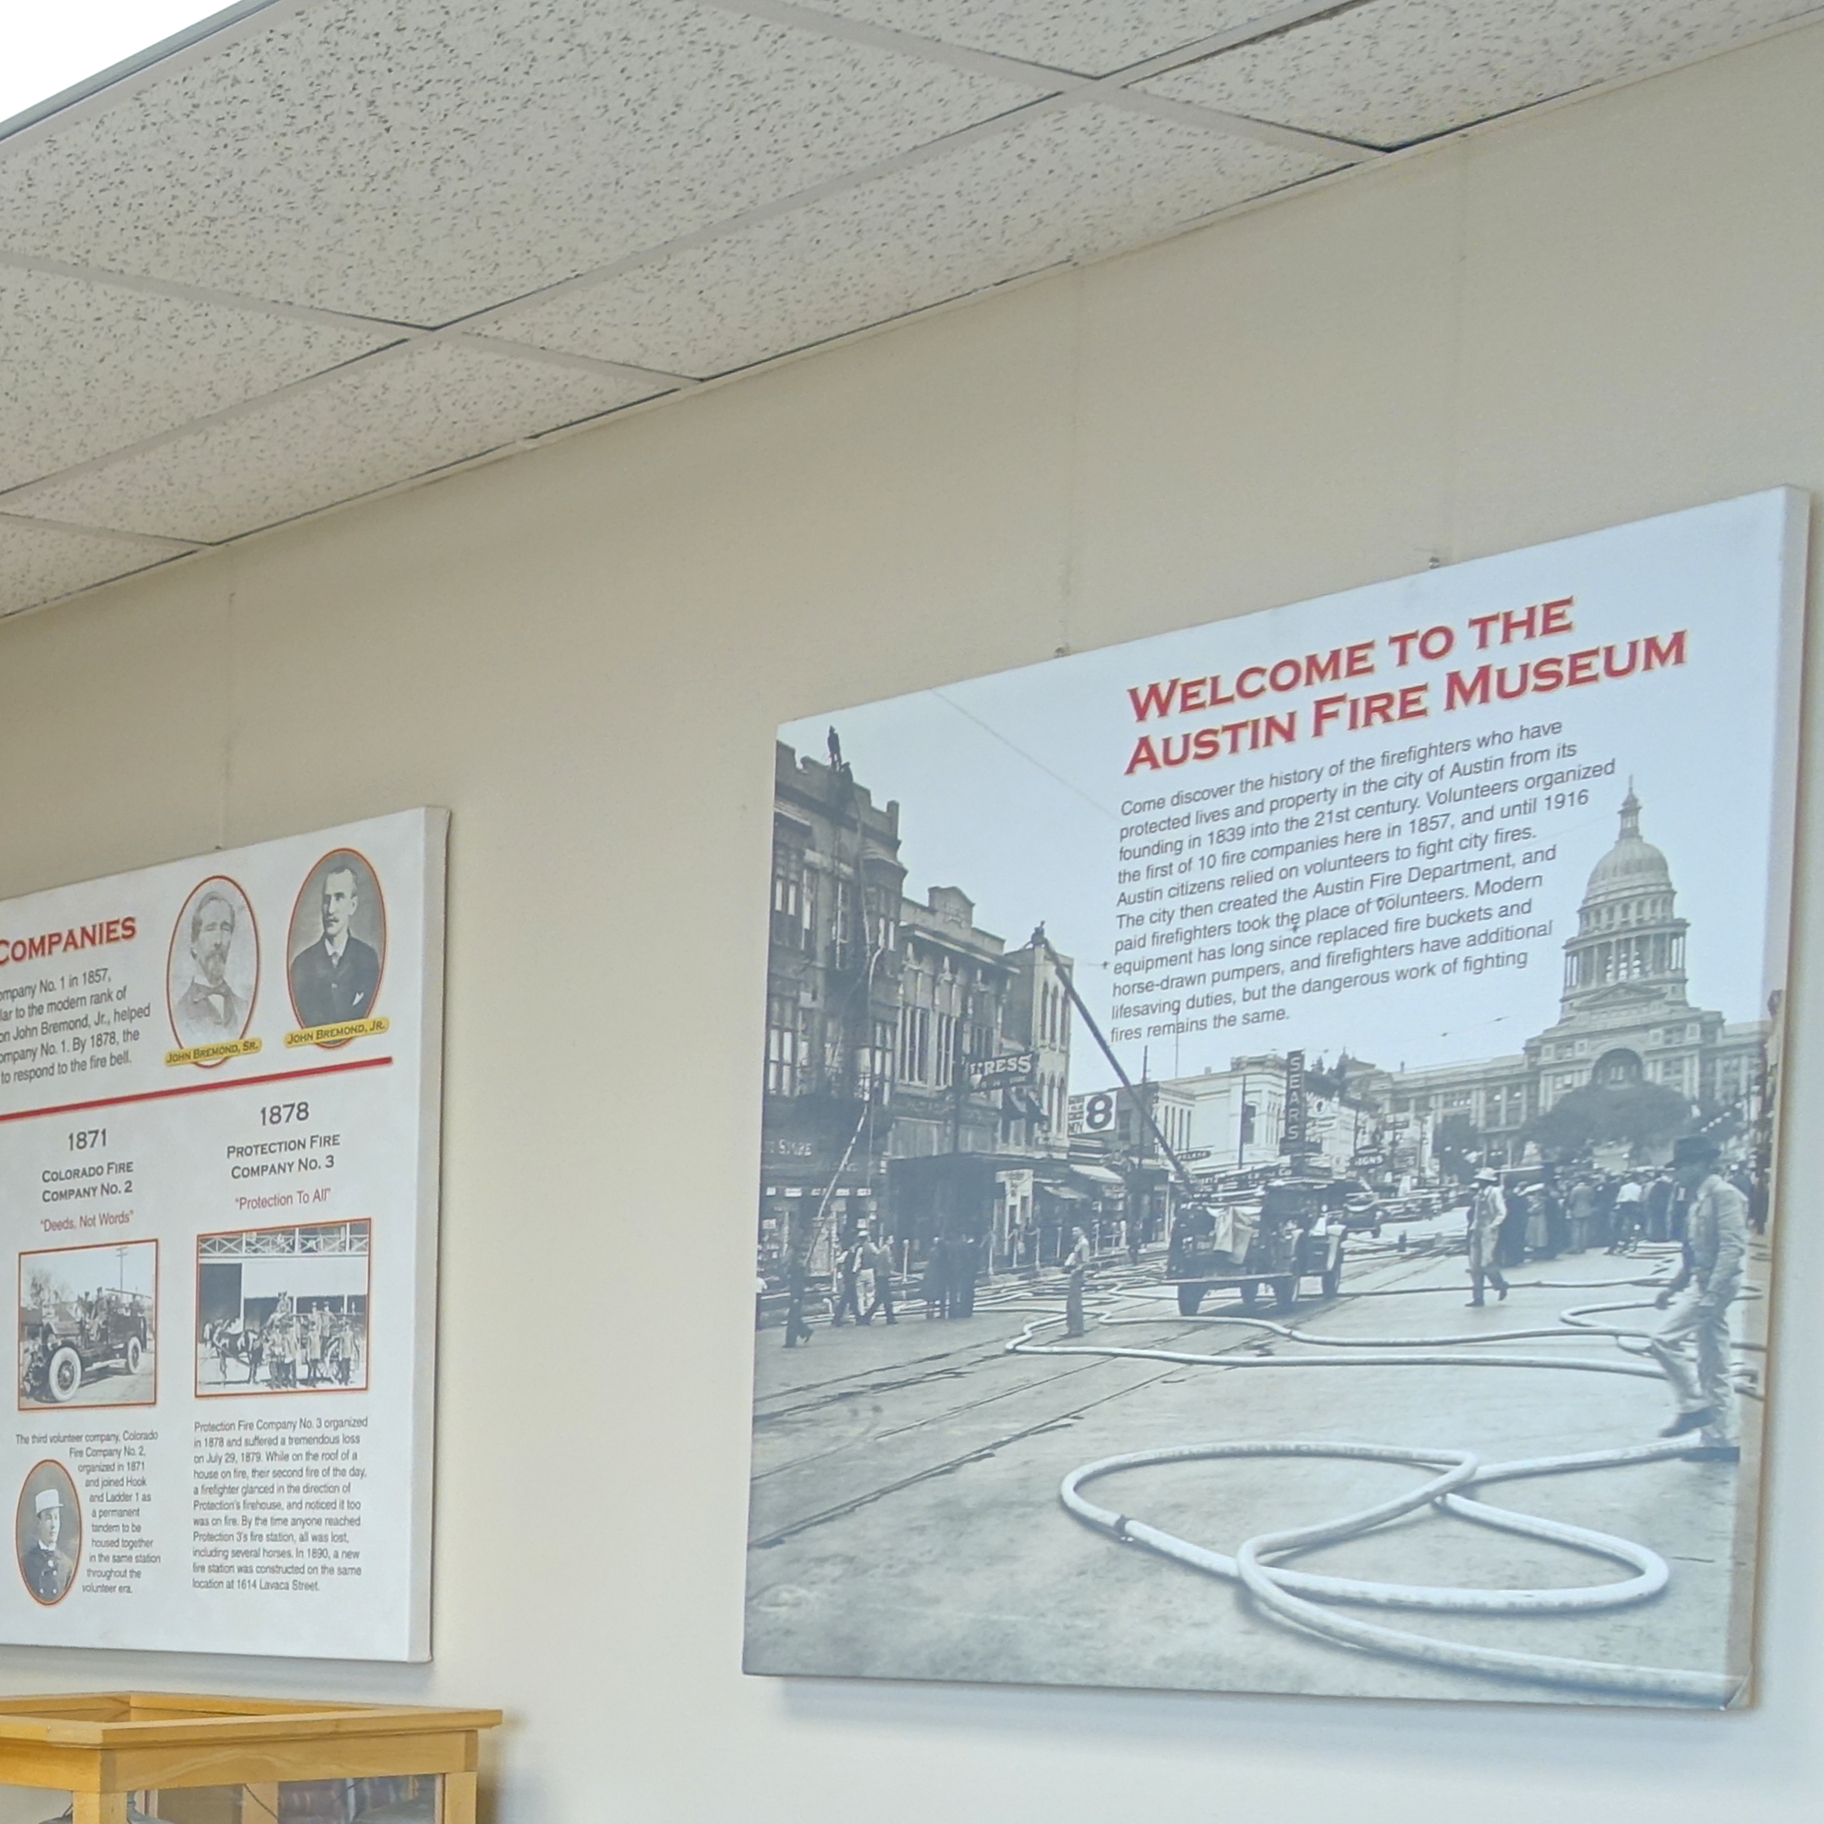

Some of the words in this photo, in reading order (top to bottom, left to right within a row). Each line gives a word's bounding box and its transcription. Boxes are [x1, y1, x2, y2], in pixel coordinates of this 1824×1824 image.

[1127, 641, 1375, 722] WELCOME
[1388, 625, 1455, 667] TO
[1468, 596, 1574, 649] THE
[1125, 711, 1296, 775] AUSTIN
[1312, 683, 1429, 737] FIRE
[1445, 631, 1686, 711] MUSEUM
[1120, 797, 1166, 817] Come
[1170, 783, 1236, 807] discover
[1239, 777, 1265, 794] the
[1268, 766, 1325, 788] history
[1328, 758, 1346, 777] of
[1349, 756, 1376, 774] the
[1380, 738, 1472, 767] firefighters
[1476, 730, 1514, 749] who
[1518, 721, 1563, 741] have
[1119, 811, 1192, 843] protected
[1194, 807, 1231, 826] lives
[1234, 797, 1265, 818] and
[1268, 787, 1338, 816] property
[1342, 782, 1357, 798] in
[1362, 778, 1389, 795] the
[1393, 771, 1424, 790] city
[1427, 763, 1446, 783] of
[1448, 755, 1504, 779] Austin
[1510, 748, 1551, 768] from
[1556, 742, 1578, 759] its
[1119, 839, 1184, 862] founding
[1188, 834, 1202, 850] in
[1207, 825, 1246, 846] 1839
[1250, 821, 1280, 839] into
[1284, 816, 1310, 832] the
[1314, 806, 1351, 827] 21st
[1354, 797, 1421, 820] century.
[1425, 779, 1519, 807] Volunteers
[1524, 758, 1616, 791] organized
[1117, 868, 1141, 885] the
[1145, 861, 1174, 880] first
[1177, 856, 1194, 875] of
[1198, 853, 1217, 871] 10
[1221, 850, 1246, 867] fire
[1250, 835, 1339, 862] companies
[1343, 828, 1382, 846] here
[1387, 822, 1402, 839] in
[1409, 812, 1455, 834] 1857,
[1461, 804, 1495, 826] and
[1500, 797, 1538, 819] until
[1544, 788, 1589, 811] 1916
[287, 1032, 314, 1045] JOHN
[316, 1024, 368, 1041] BREMOND,
[166, 1050, 192, 1064] JOHN
[1287, 1056, 1302, 1140] SEARS
[260, 1101, 310, 1126] 1878
[1085, 1093, 1113, 1130] 8
[68, 1127, 107, 1152] 1871
[226, 1138, 307, 1159] PROTECTION
[309, 1133, 341, 1149] FIRE
[41, 1165, 105, 1184] COLORADO
[106, 1161, 134, 1176] FIRE
[230, 1161, 295, 1180] COMPANY
[297, 1157, 322, 1172] NO.
[325, 1154, 335, 1169] 3
[41, 1185, 99, 1203] COMPANY
[100, 1182, 122, 1197] NO.
[123, 1179, 133, 1194] 2
[296, 1189, 310, 1204] To
[79, 1214, 97, 1228] Not
[194, 1420, 236, 1433] Protection
[237, 1419, 255, 1431] Fire
[255, 1418, 298, 1433] Company
[298, 1417, 314, 1430] No.
[315, 1417, 323, 1429] 3
[323, 1416, 369, 1432] organized
